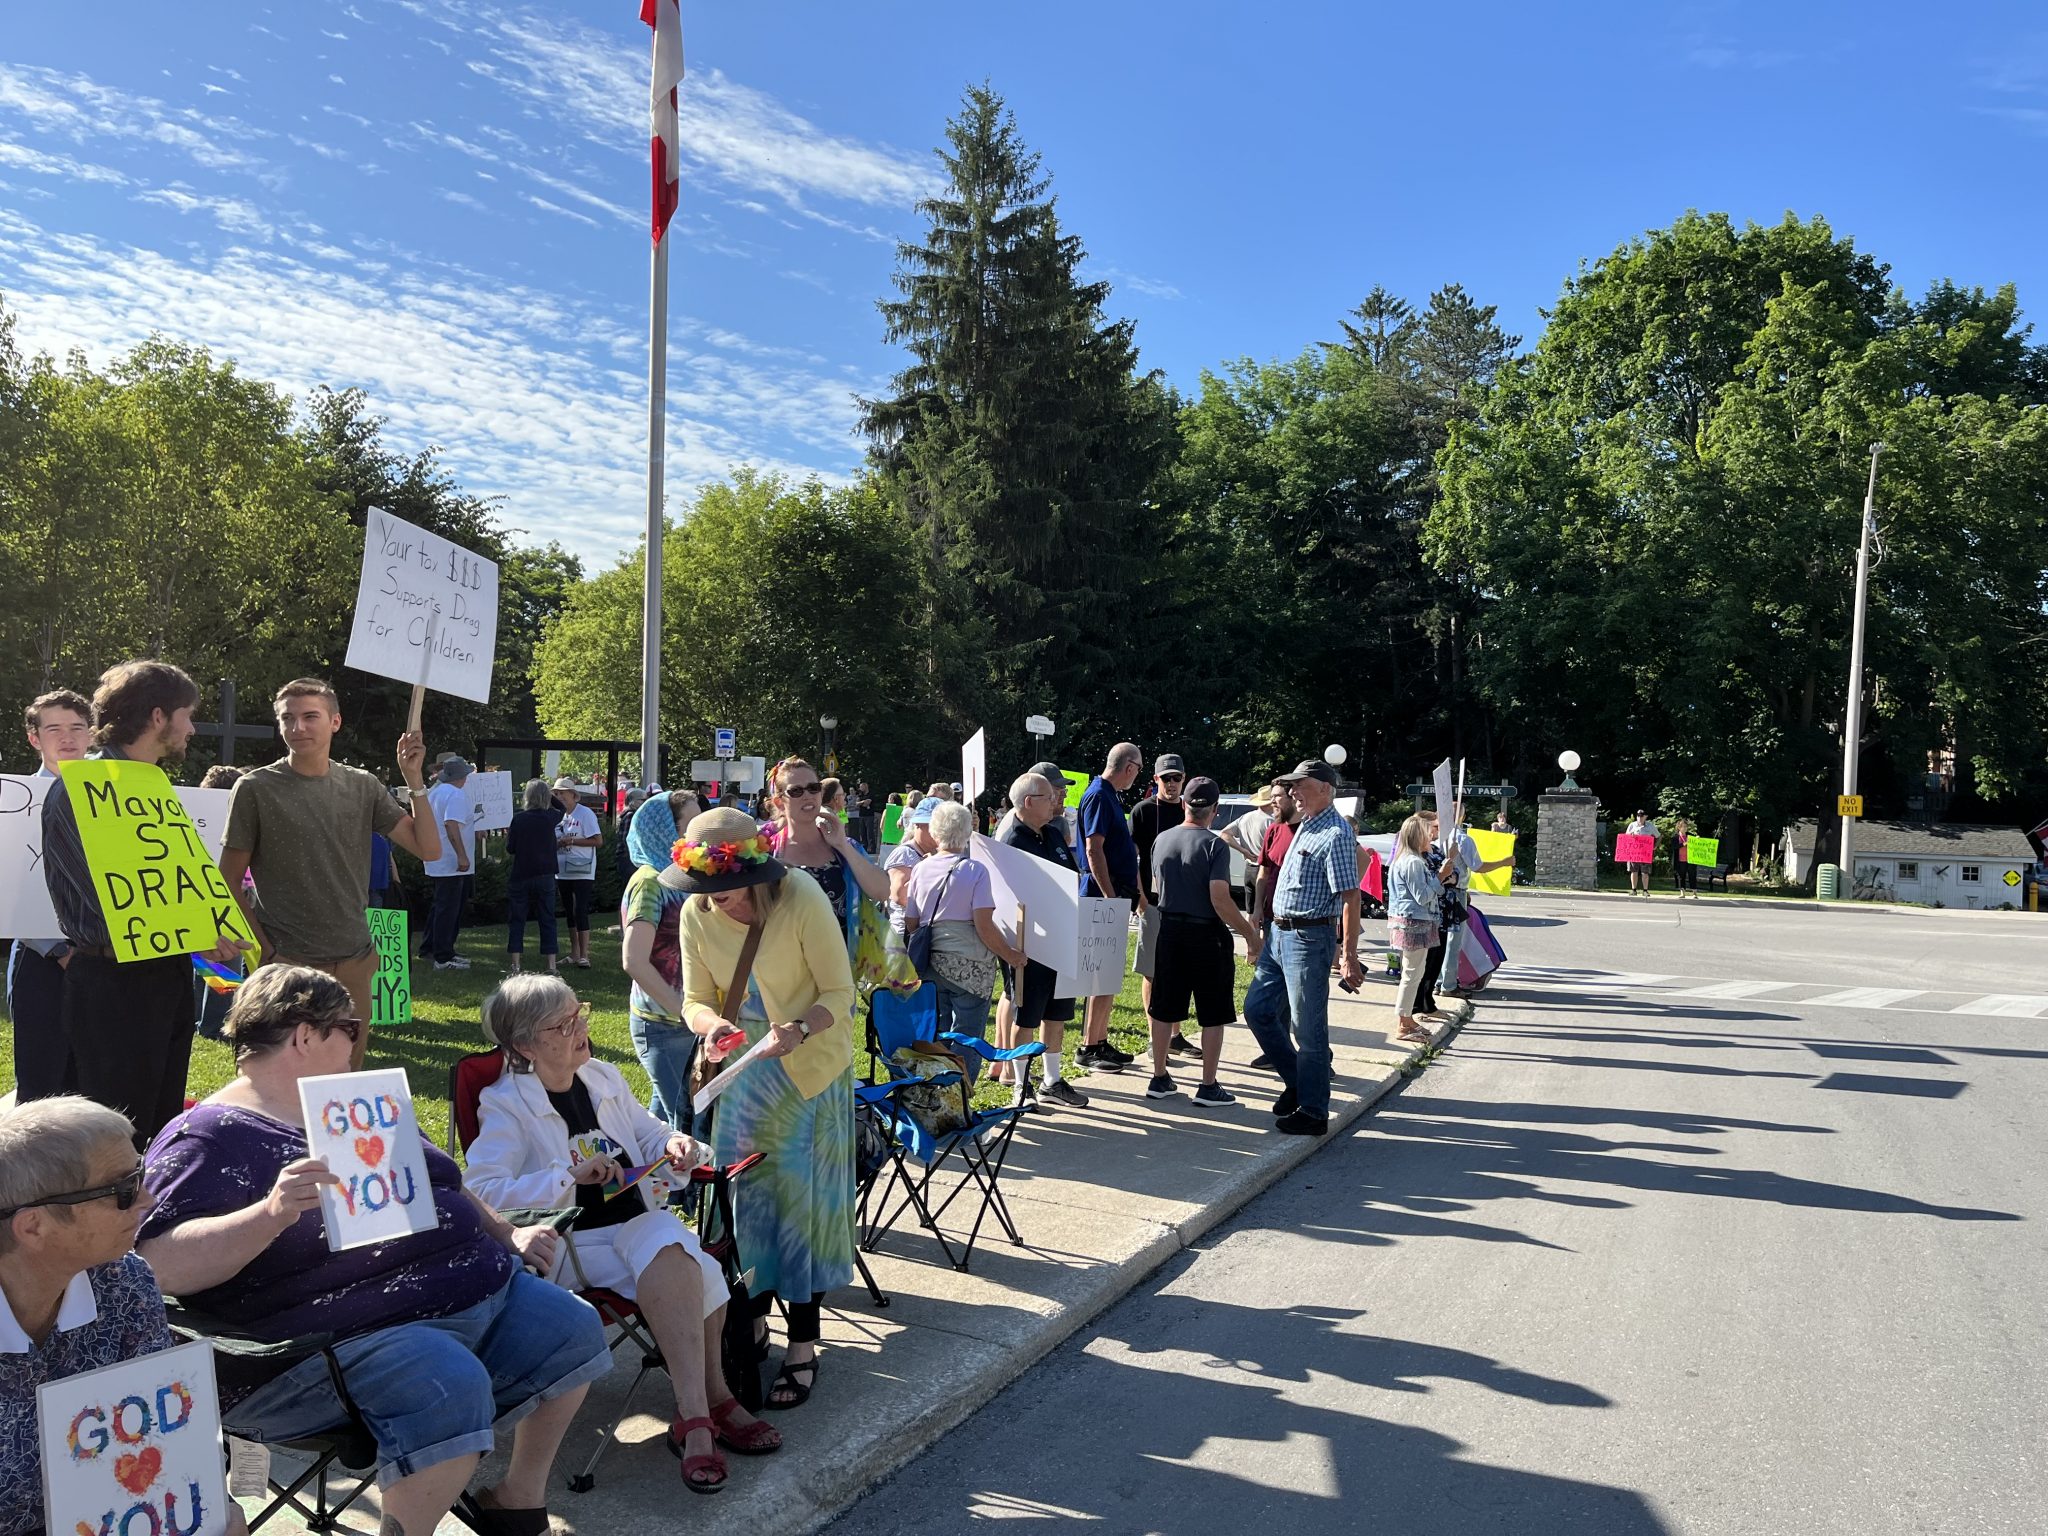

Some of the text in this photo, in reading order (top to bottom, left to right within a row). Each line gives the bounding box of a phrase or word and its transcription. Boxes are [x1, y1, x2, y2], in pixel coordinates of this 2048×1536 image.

[380, 517, 482, 591] Your tax $$$
[380, 565, 480, 637] Supports Drag
[367, 604, 474, 664] for Children
[0, 778, 42, 816] Dr
[1420, 786, 1436, 794] JER
[1478, 787, 1502, 795] PARK
[1841, 805, 1858, 813] EXIT
[136, 822, 213, 862] ST
[105, 864, 230, 911] DRAG
[123, 905, 254, 957] for KI
[369, 910, 401, 935] AG
[374, 934, 402, 952] NTS
[377, 954, 403, 973] IDS
[1077, 936, 1117, 954] ooming
[370, 976, 408, 1021] HY?
[321, 1094, 400, 1137] GOD
[336, 1166, 416, 1217] YOU
[67, 1381, 193, 1459] GOD
